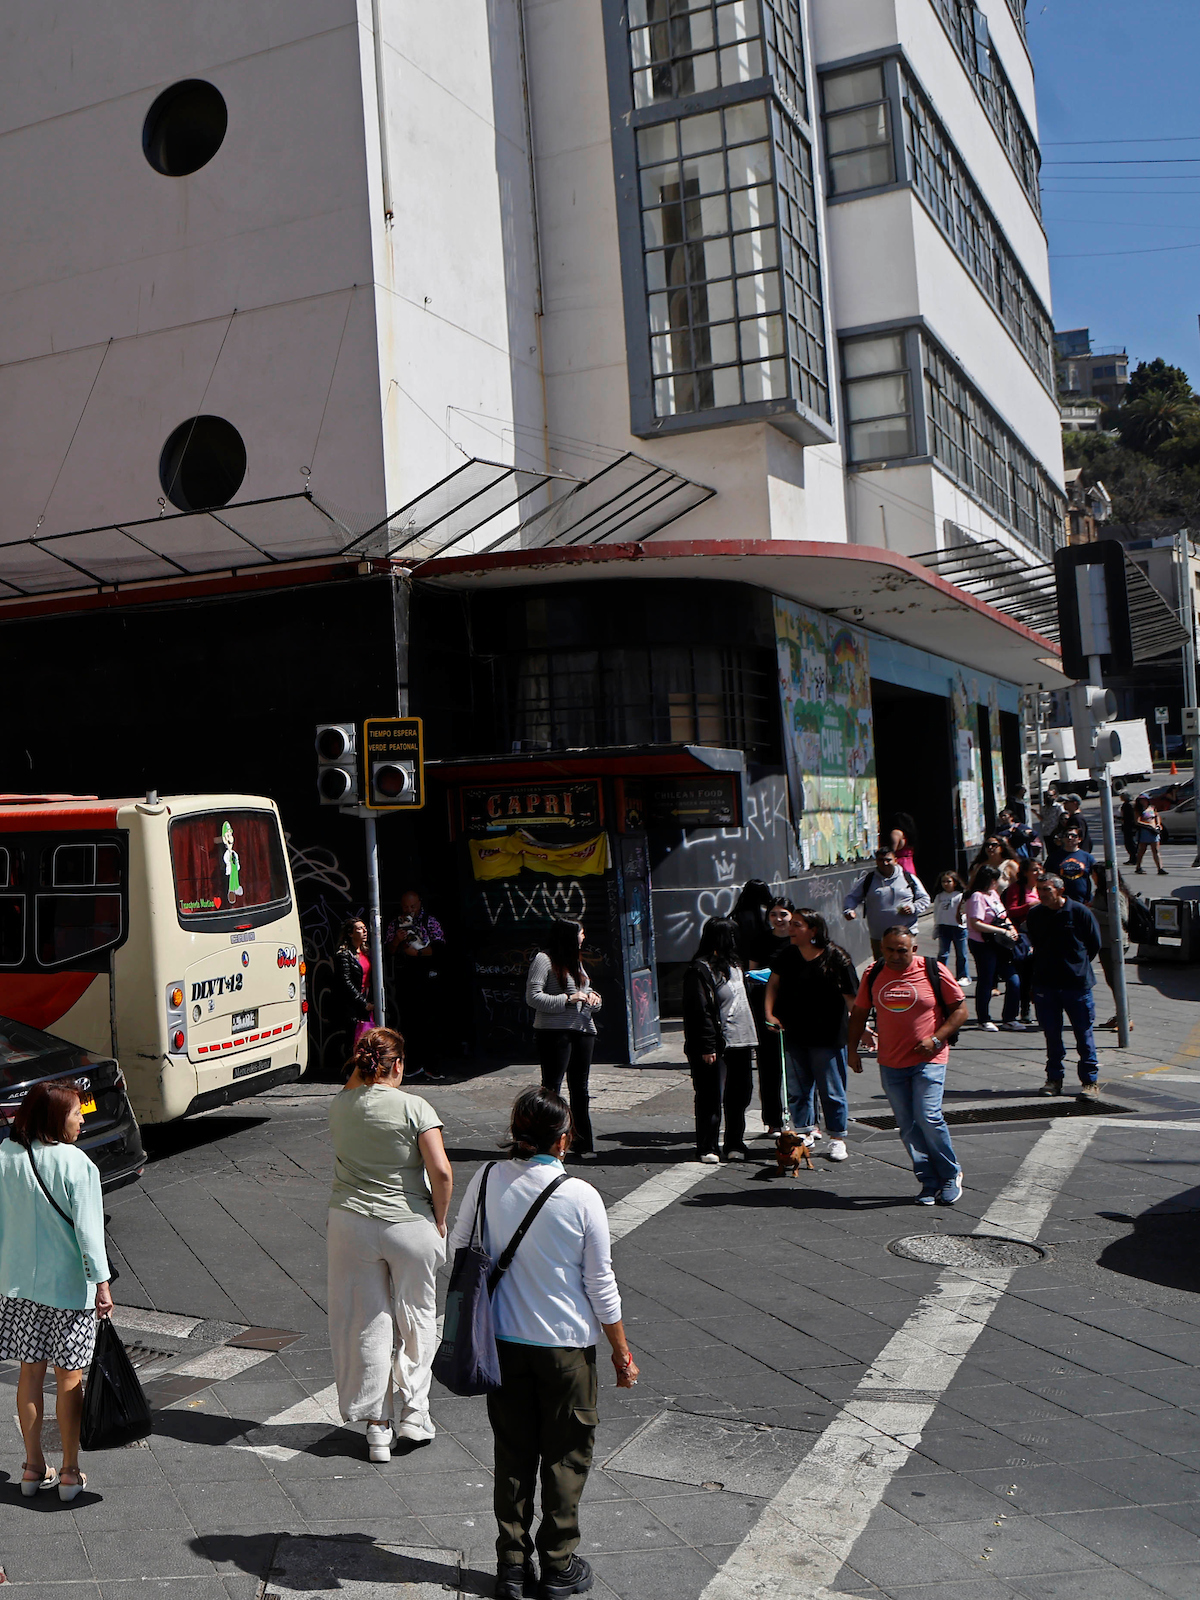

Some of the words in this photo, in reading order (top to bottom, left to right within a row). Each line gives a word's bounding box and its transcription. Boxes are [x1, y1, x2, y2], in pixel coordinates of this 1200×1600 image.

[369, 730, 392, 738] TIEMPO
[393, 729, 417, 737] ESPERA
[389, 743, 418, 751] PEATONAL
[698, 789, 723, 798] FOOD
[486, 792, 575, 818] CAPRI
